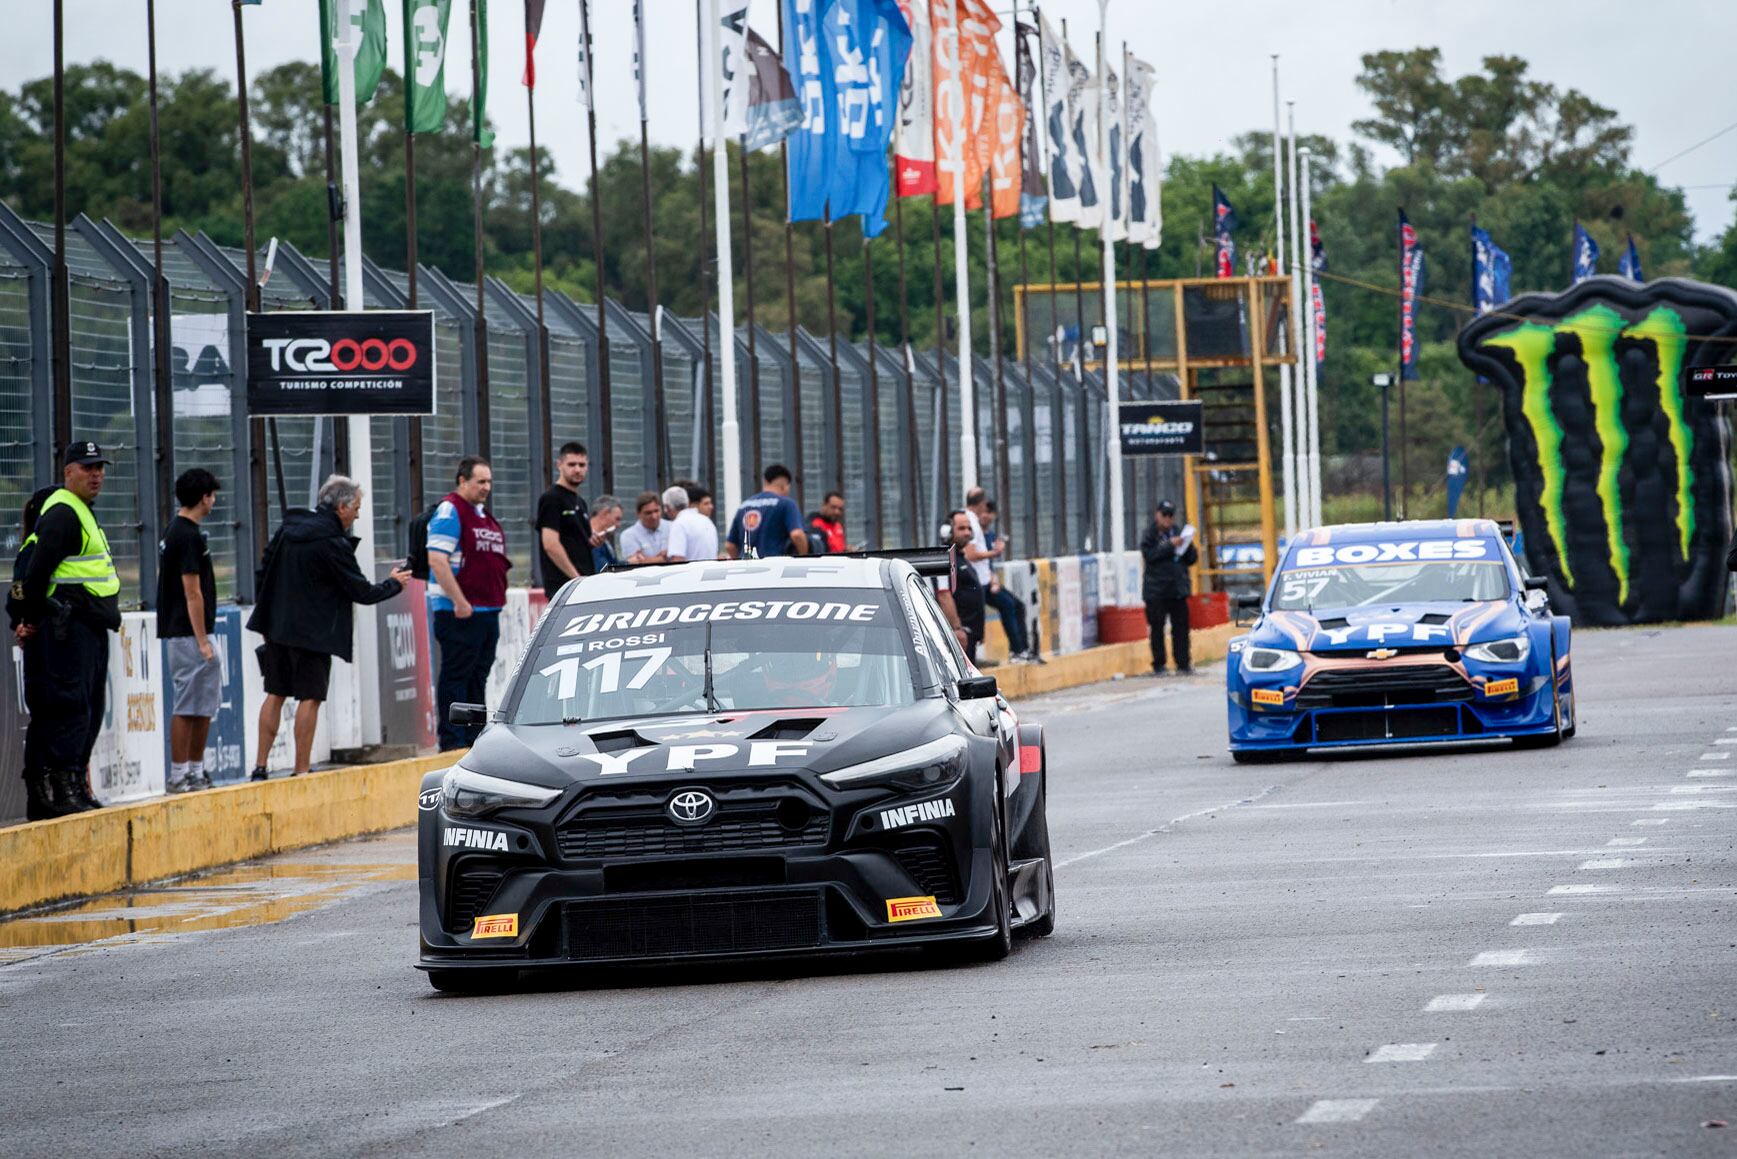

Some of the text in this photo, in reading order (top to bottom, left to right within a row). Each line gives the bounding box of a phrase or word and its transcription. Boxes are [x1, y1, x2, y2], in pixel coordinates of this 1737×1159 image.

[262, 338, 417, 372] TC2000
[280, 379, 403, 390] TURISMO COMPETICIÓN
[1296, 539, 1487, 567] BOXES
[616, 565, 845, 588] YPF
[1295, 569, 1338, 580] VIVIAN
[1281, 578, 1330, 601] 57
[558, 600, 880, 638] BRIDGESTONE
[588, 633, 665, 651] ROSSI
[1319, 622, 1450, 646] YPF
[539, 646, 673, 700] 117
[578, 741, 814, 775] YPF
[880, 798, 956, 830] INFINIA
[443, 827, 509, 851] INFINIA
[890, 901, 936, 917] PIRELLI
[475, 918, 513, 934] PIRELLI
